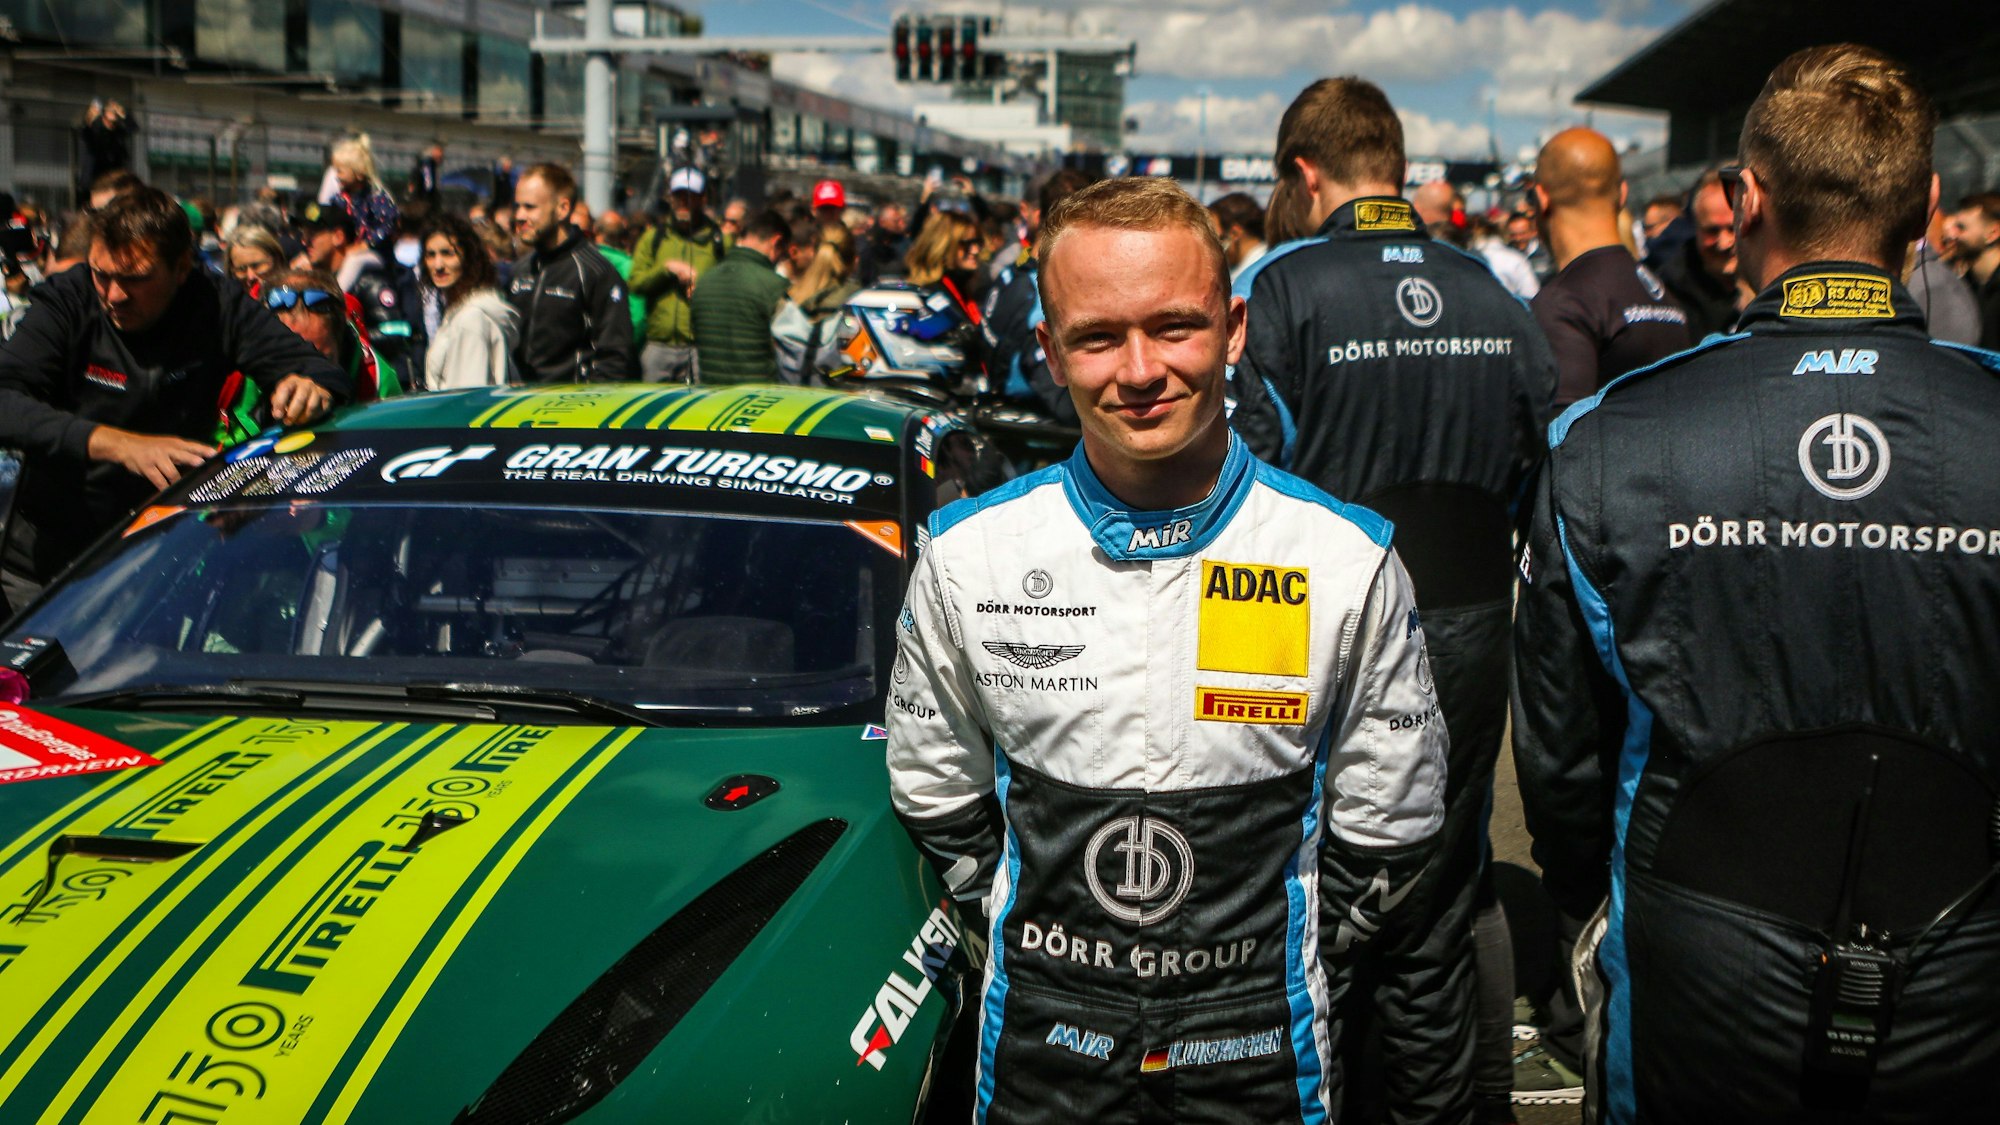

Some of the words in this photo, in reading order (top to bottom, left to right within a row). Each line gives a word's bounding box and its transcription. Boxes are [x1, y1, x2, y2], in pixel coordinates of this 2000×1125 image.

[1329, 339, 1389, 365] DÖRR
[1395, 337, 1513, 358] MOTORSPORT
[502, 468, 547, 481] THE
[551, 469, 612, 483] REAL
[616, 471, 712, 488] DRIVING
[717, 478, 854, 505] SIMULATOR
[505, 444, 650, 471] GRAN
[651, 446, 872, 493] TURISMO
[1669, 515, 1767, 549] DÖRR
[1781, 520, 2000, 556] MOTORSPOR
[1206, 565, 1306, 606] ADAC
[976, 600, 1010, 615] DÖRR
[1013, 605, 1097, 618] MOTORSPORT
[975, 672, 1024, 690] ASTON
[1031, 677, 1098, 692] MARTIN
[894, 695, 936, 720] GROUP
[1203, 692, 1301, 720] PIRELLI
[238, 840, 421, 997] PIRELLI
[1021, 921, 1114, 969] DÖRR
[1130, 938, 1257, 978] GROUP
[850, 900, 960, 1071] FALKEN
[274, 1014, 315, 1058] YEARS
